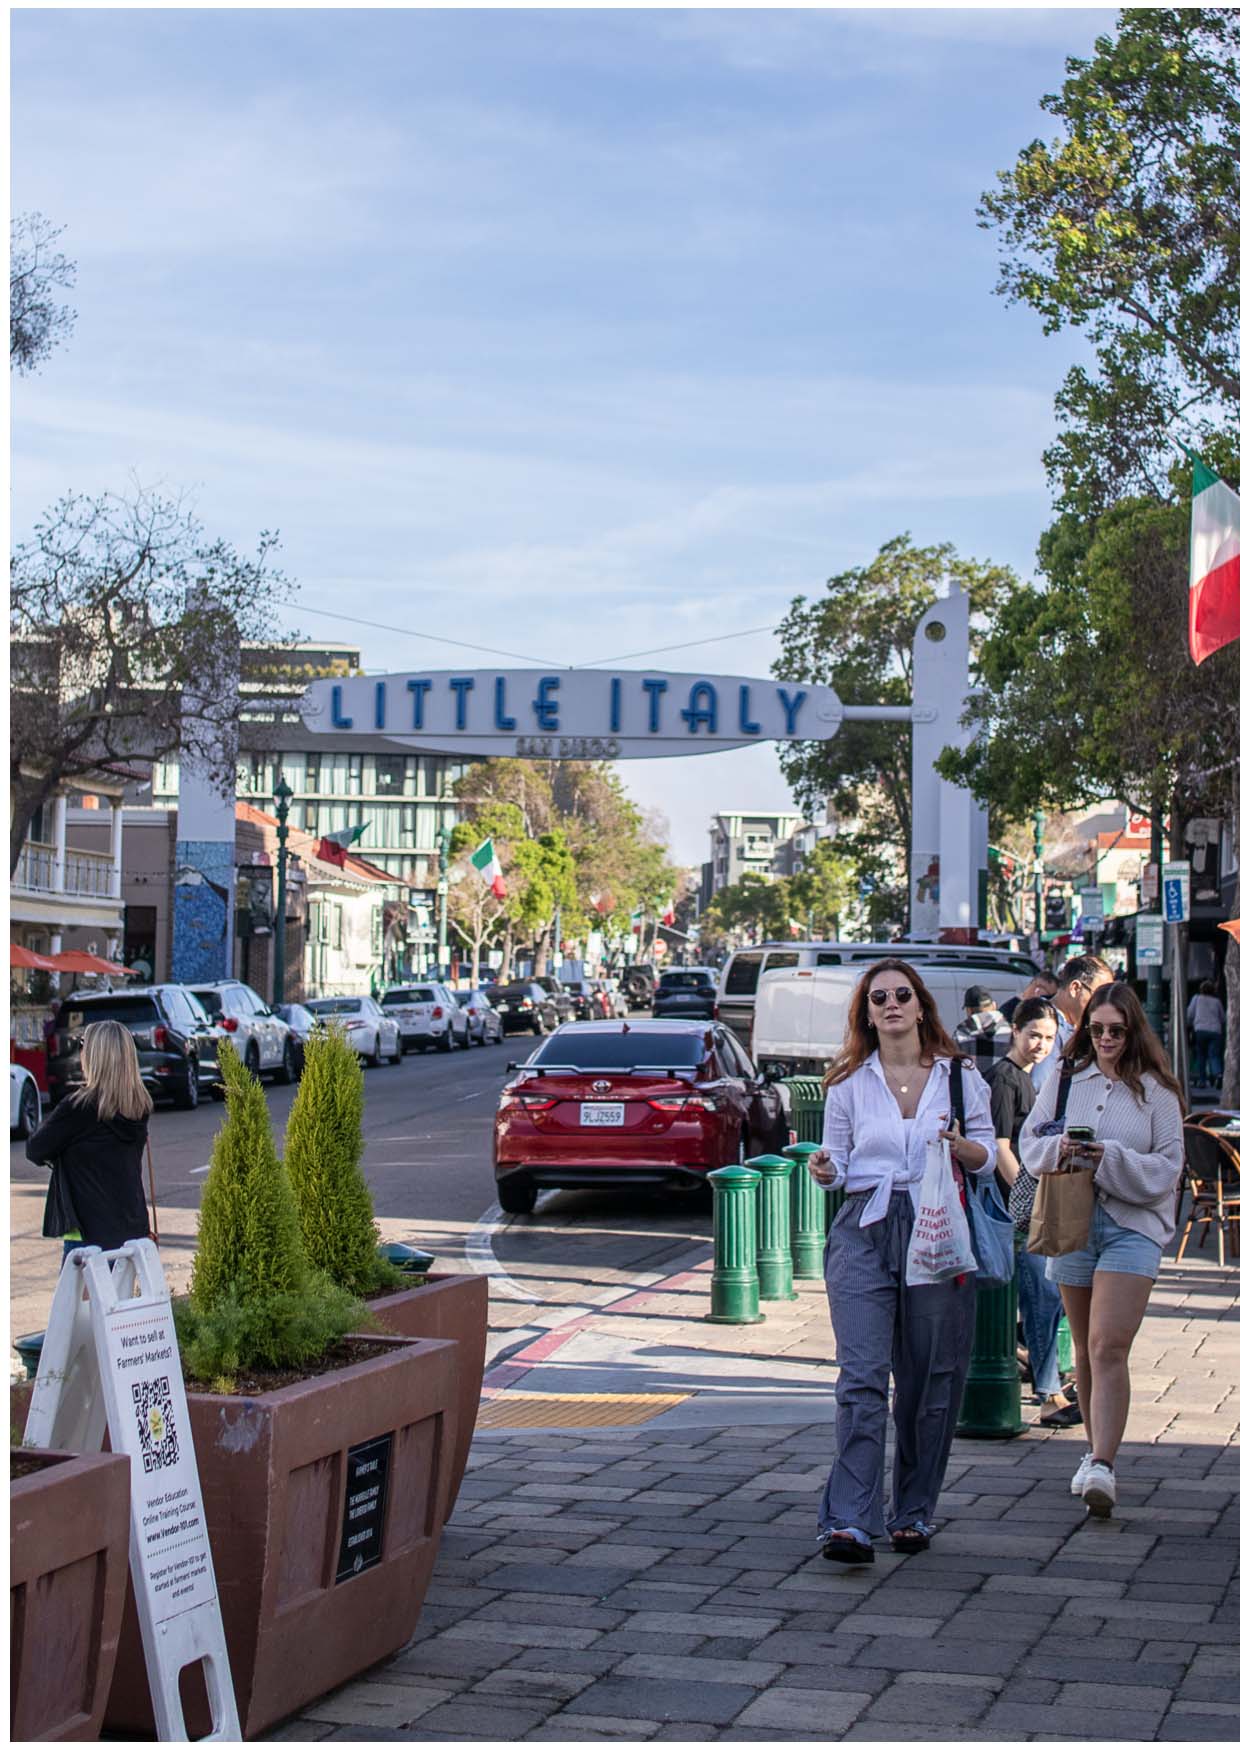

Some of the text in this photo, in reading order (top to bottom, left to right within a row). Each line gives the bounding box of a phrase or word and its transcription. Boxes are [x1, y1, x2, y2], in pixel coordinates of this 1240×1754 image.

[331, 676, 808, 735] LITTLE ITALY
[516, 736, 621, 758] SAN DIEGO
[120, 1330, 165, 1349] Want to sell at
[145, 1347, 172, 1363] Markets?
[147, 1488, 188, 1508] Vendor Education
[142, 1514, 159, 1526] Online
[159, 1506, 179, 1520] Training
